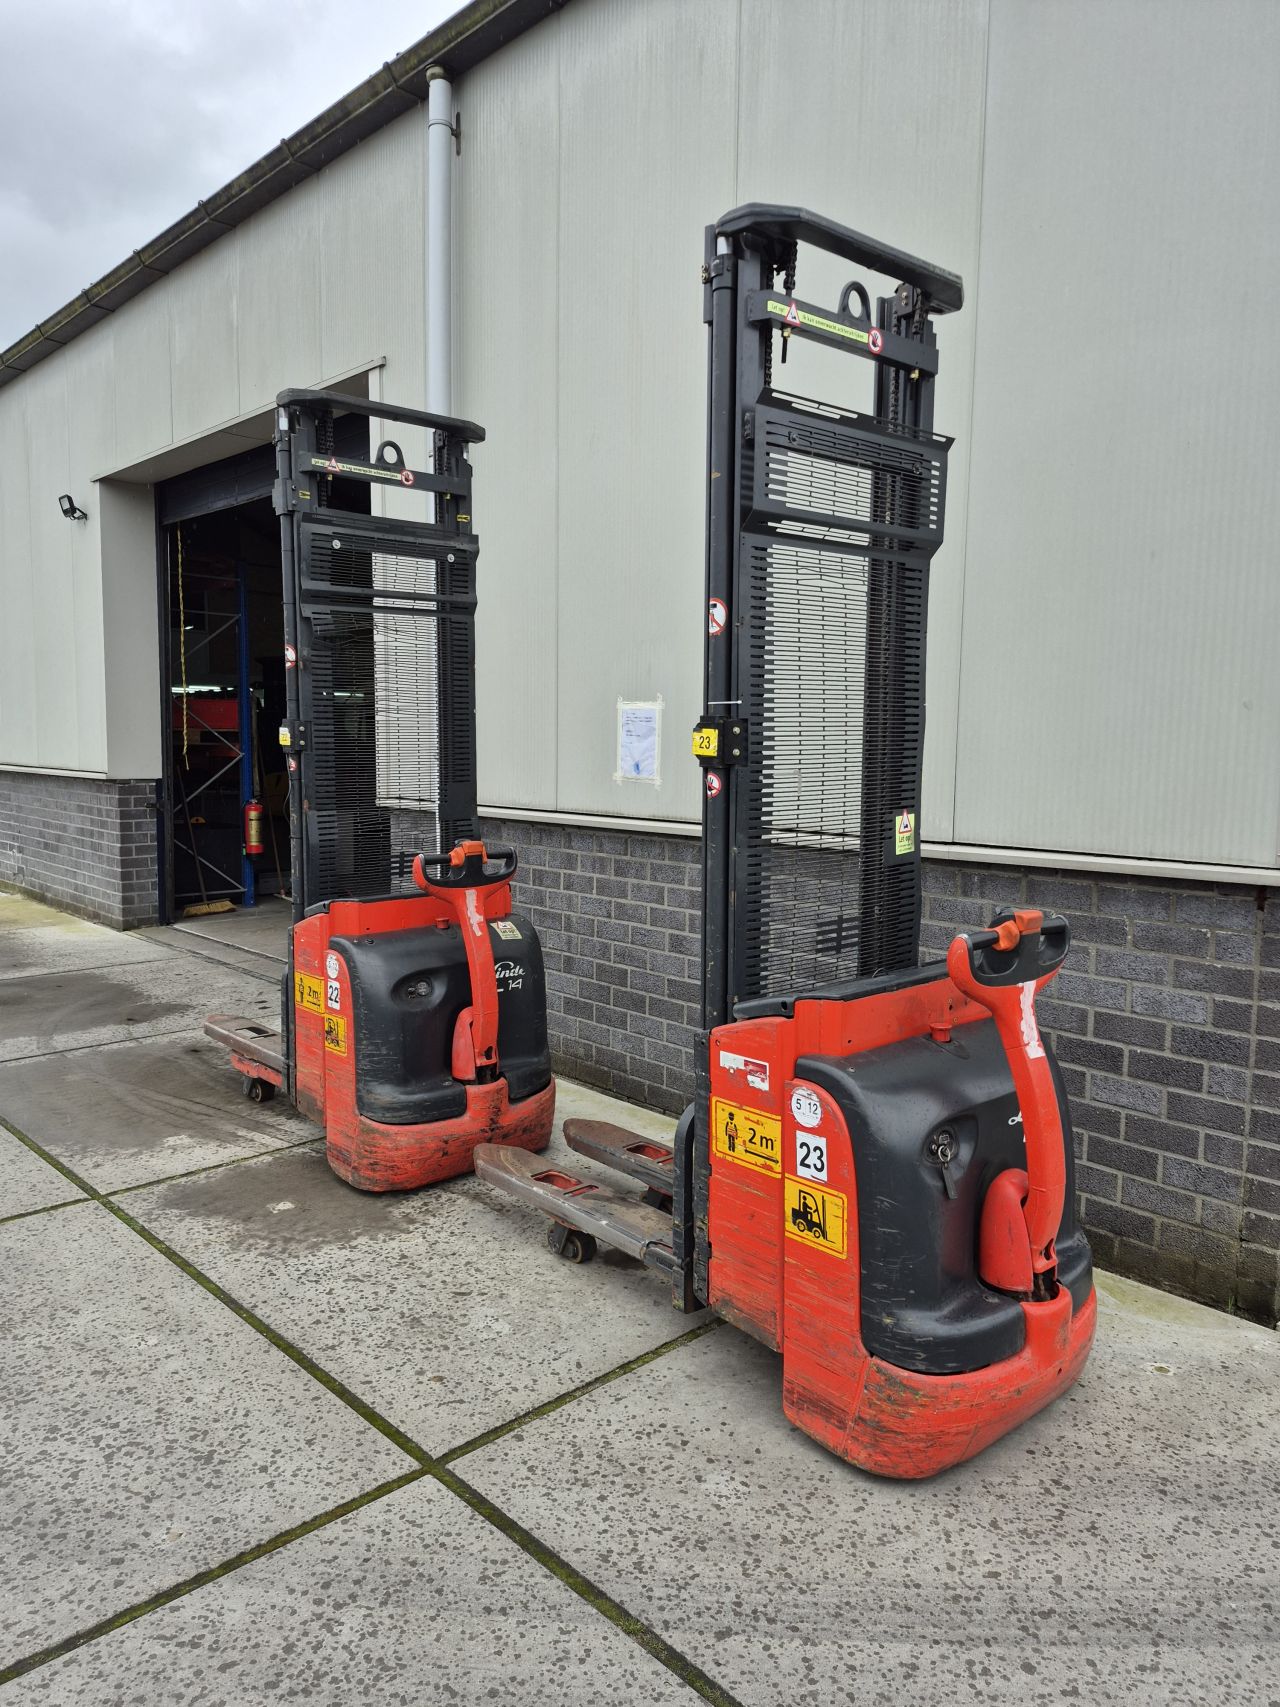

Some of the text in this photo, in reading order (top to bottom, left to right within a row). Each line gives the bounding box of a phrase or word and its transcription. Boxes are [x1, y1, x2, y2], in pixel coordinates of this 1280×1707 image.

[699, 736, 710, 749] 23
[508, 979, 522, 991] 14
[328, 985, 339, 1004] 22
[796, 1098, 818, 1115] 5 12
[748, 1128, 774, 1151] 2 m
[799, 1141, 825, 1172] 23
